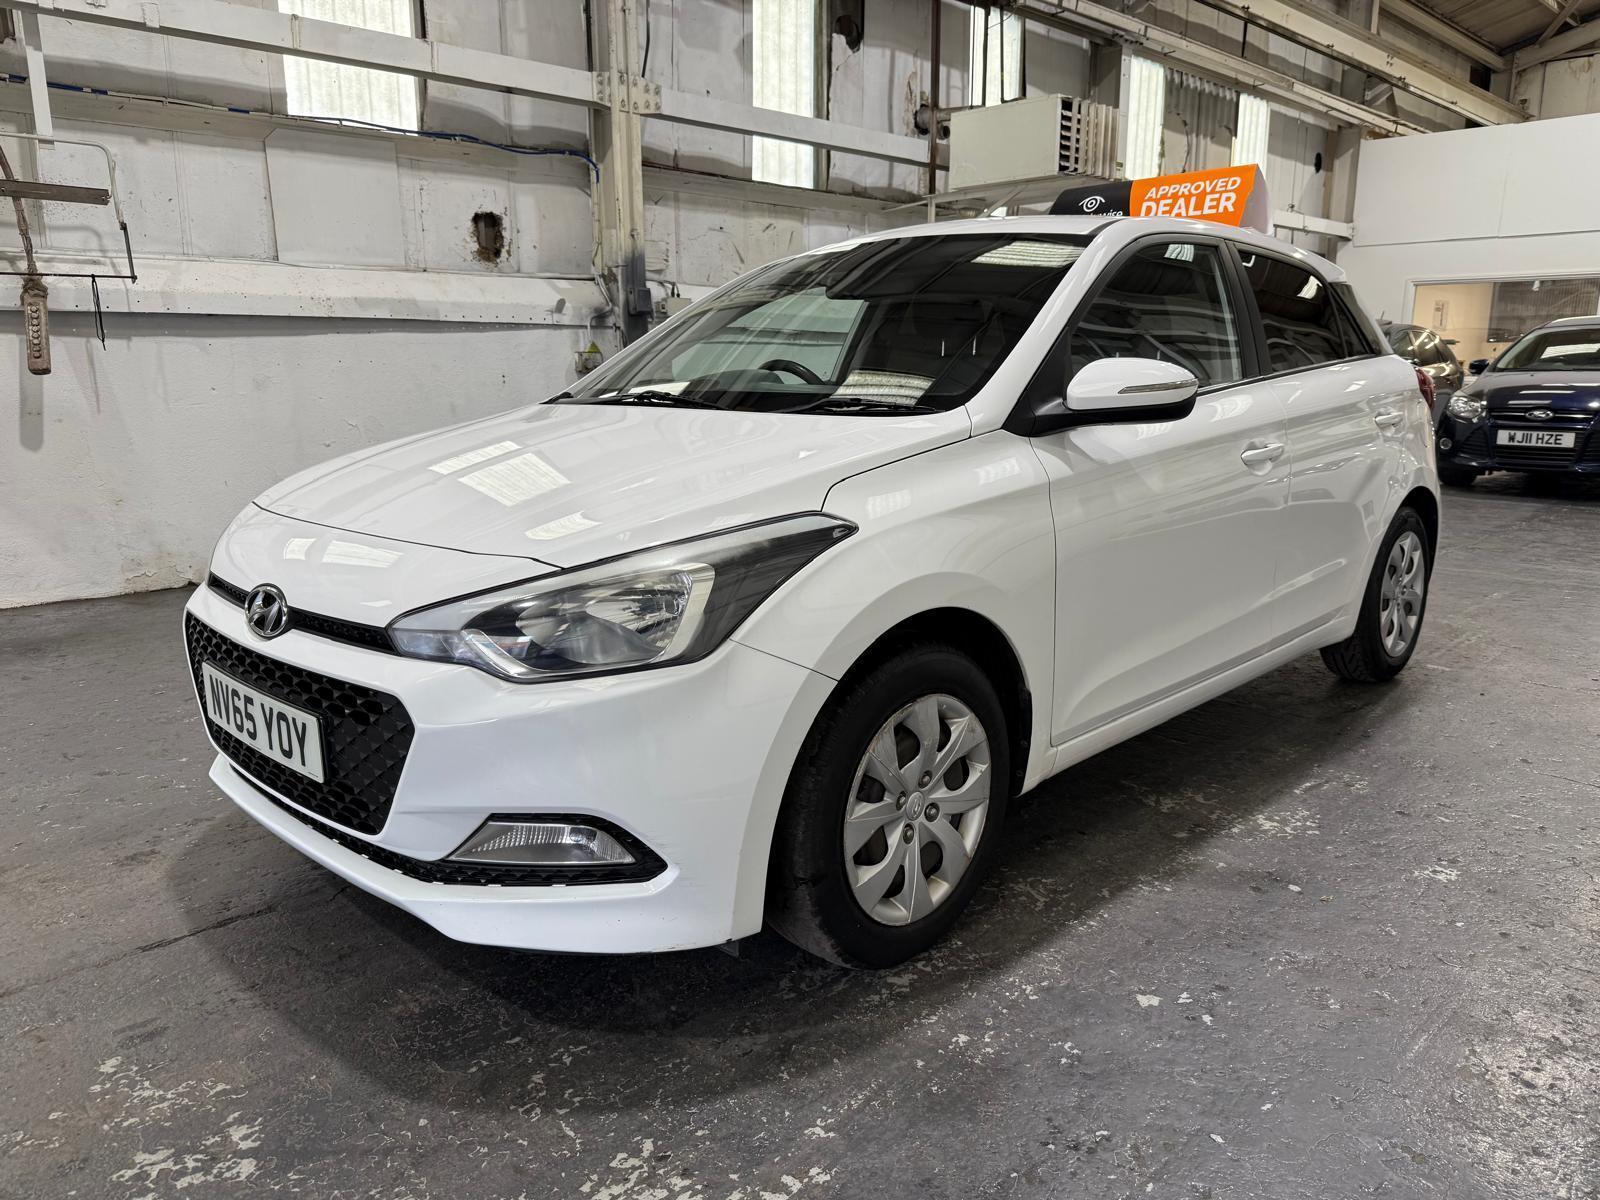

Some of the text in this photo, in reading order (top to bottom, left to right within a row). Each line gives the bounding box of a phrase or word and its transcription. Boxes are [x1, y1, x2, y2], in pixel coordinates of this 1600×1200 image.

[1144, 176, 1241, 199] APPROVED
[1140, 193, 1236, 217] DEALER
[1508, 432, 1564, 446] WJ11 HZE
[209, 674, 306, 767] NV65 YOY
